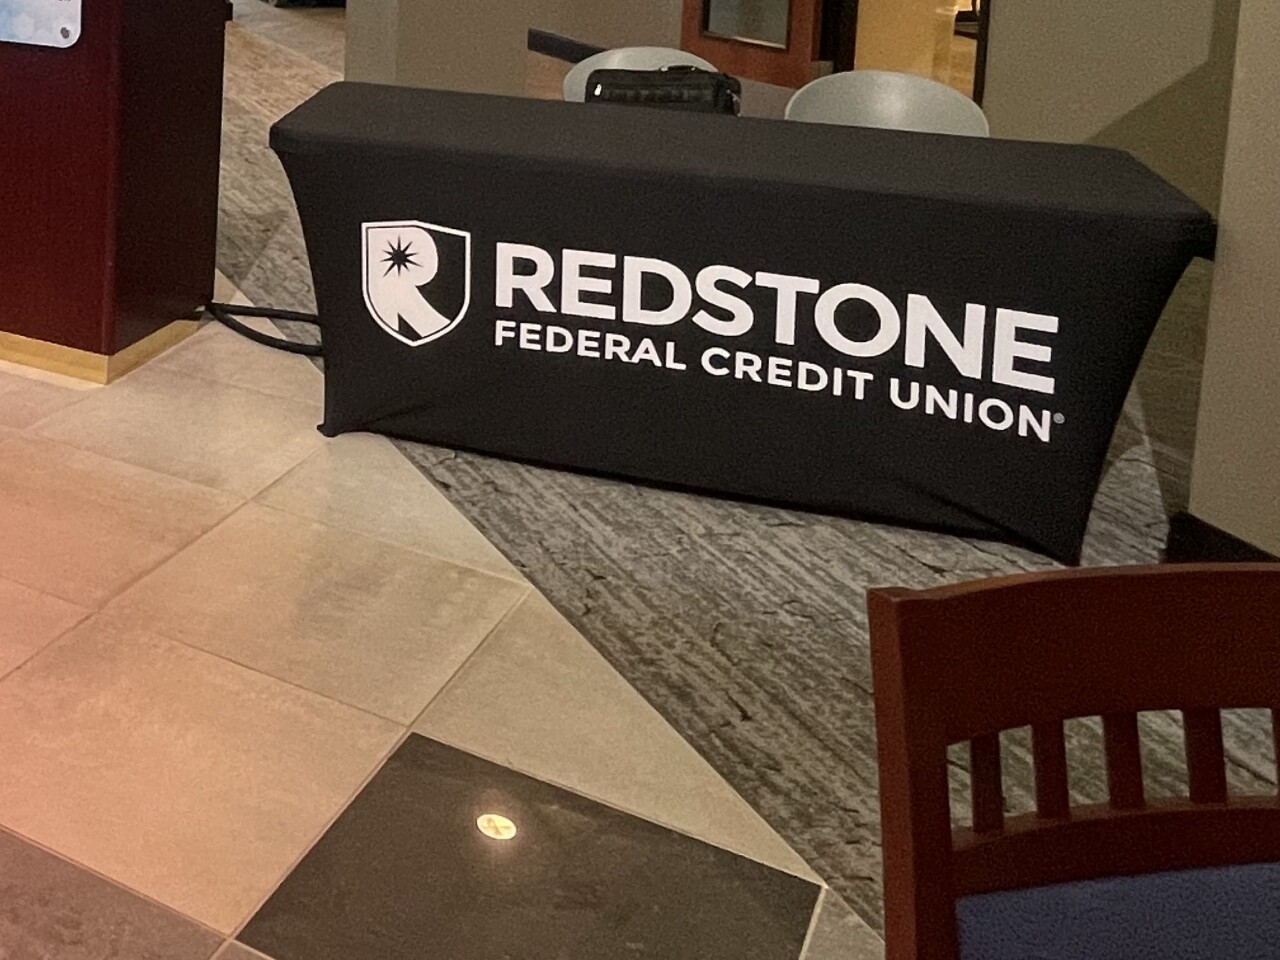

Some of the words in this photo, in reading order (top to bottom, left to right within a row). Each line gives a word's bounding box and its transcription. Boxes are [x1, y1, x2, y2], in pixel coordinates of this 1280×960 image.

[494, 241, 1060, 395] REDSTONE
[494, 319, 687, 371] FEDERAL
[700, 345, 874, 400] CREDIT
